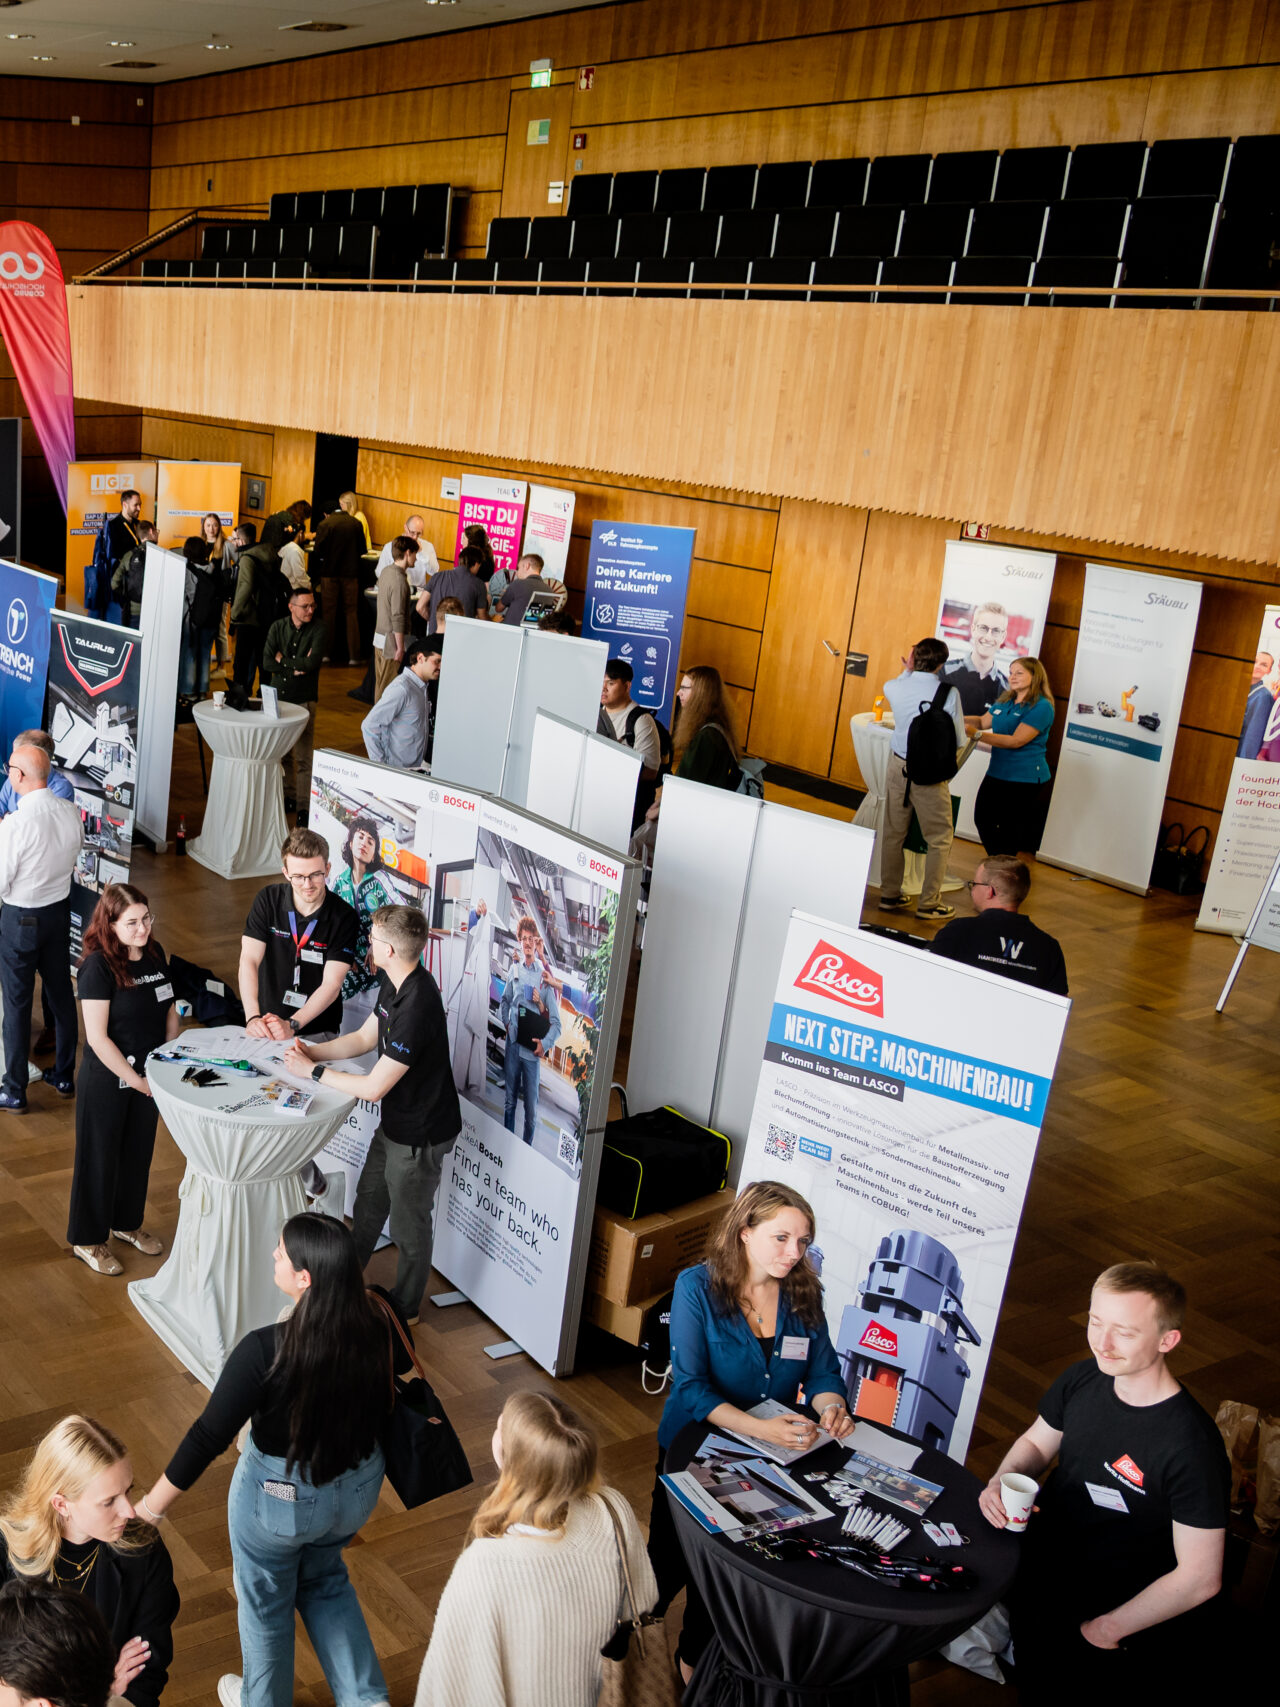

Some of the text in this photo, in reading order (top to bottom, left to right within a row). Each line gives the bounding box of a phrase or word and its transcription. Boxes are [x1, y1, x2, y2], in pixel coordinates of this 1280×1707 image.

[91, 474, 135, 490] IGZ
[463, 502, 518, 525] BIST DU
[490, 523, 516, 538] NEUES
[594, 579, 659, 595] mit Zukunft!
[596, 565, 673, 583] Deine Karriere
[74, 637, 116, 655] TAURUS
[317, 762, 360, 780] invented for life
[443, 794, 475, 812] BOSCH
[1235, 798, 1255, 807] der
[589, 857, 619, 881] BOSCH
[801, 953, 881, 1007] Lasco
[781, 1051, 900, 1096] Komm ins Team LASCO
[784, 1013, 1034, 1112] NEXT STEP: MASCHINENBAU!
[771, 1101, 784, 1112] und
[785, 1107, 870, 1149] Automatisierungstechnik
[881, 1148, 962, 1188] Sondermaschinenbau
[774, 1088, 832, 1120] Blechumformung
[907, 1143, 918, 1154] für
[919, 1149, 931, 1160] die
[932, 1155, 1006, 1193] Baustofferzeugung
[776, 1077, 798, 1092] LASCO
[803, 1088, 832, 1106] Präzision
[832, 1102, 841, 1110] im
[938, 1144, 992, 1172] Metallmassiv-
[993, 1168, 1010, 1180] und
[459, 1129, 504, 1169] LikeABosch
[453, 1144, 560, 1242] Find a team who
[835, 1178, 910, 1219] Teams in COBURG!
[837, 1165, 987, 1237] Maschinenbaus werde Teil unseres
[840, 1153, 978, 1219] Gestalte mit uns die Zukunft des
[451, 1167, 542, 1256] has your back.
[862, 1327, 897, 1352] Lasco
